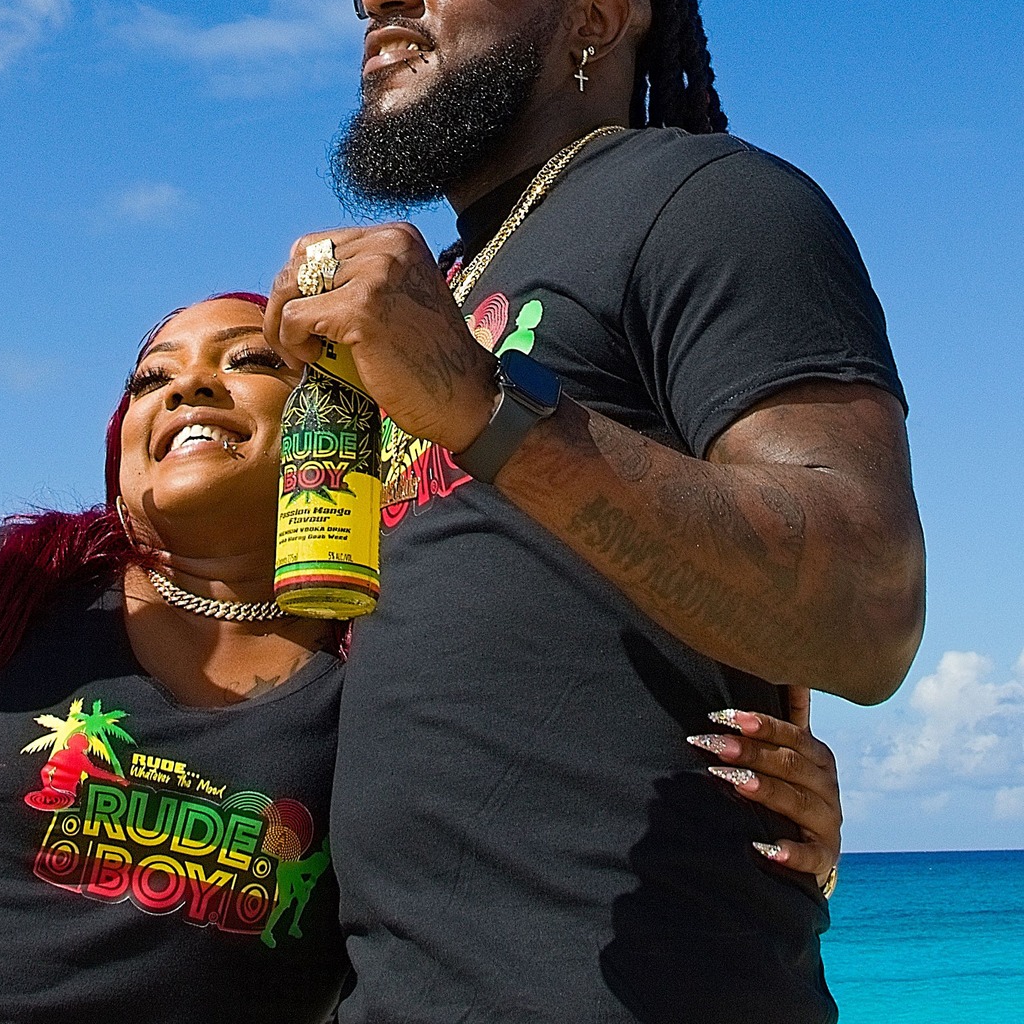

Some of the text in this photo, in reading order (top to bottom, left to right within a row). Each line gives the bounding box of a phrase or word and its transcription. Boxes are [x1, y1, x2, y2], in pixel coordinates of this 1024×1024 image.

[281, 431, 357, 464] RUDE
[283, 460, 349, 493] BOY
[288, 516, 330, 525] Flavour
[313, 506, 351, 517] Mango
[327, 526, 351, 534] DRINK
[177, 773, 192, 788] The
[196, 779, 227, 799] Mood
[83, 784, 263, 870] RUDE
[86, 843, 235, 921] BOY
